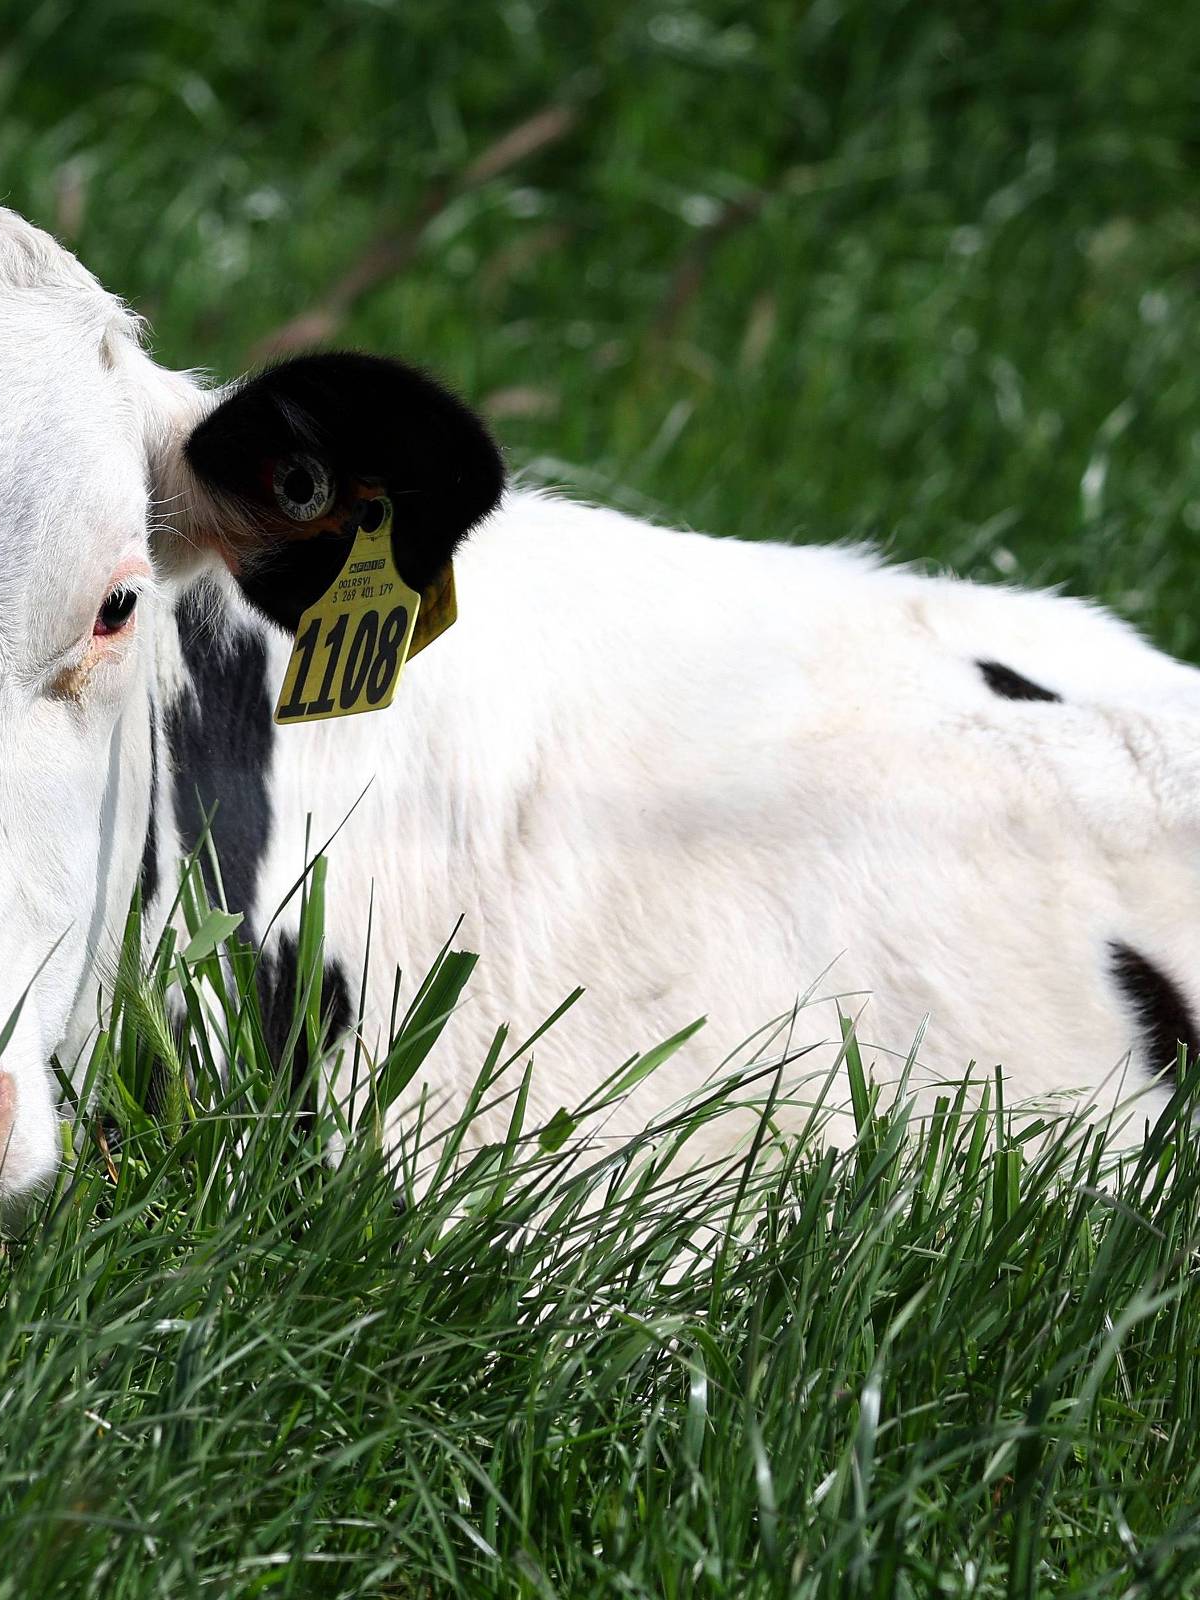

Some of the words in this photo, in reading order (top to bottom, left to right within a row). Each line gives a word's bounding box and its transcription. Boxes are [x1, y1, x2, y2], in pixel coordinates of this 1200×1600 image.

[332, 591, 338, 603] 3
[342, 589, 356, 602] 269
[361, 586, 374, 598] 401
[379, 583, 394, 596] 179
[278, 605, 408, 718] 1108
